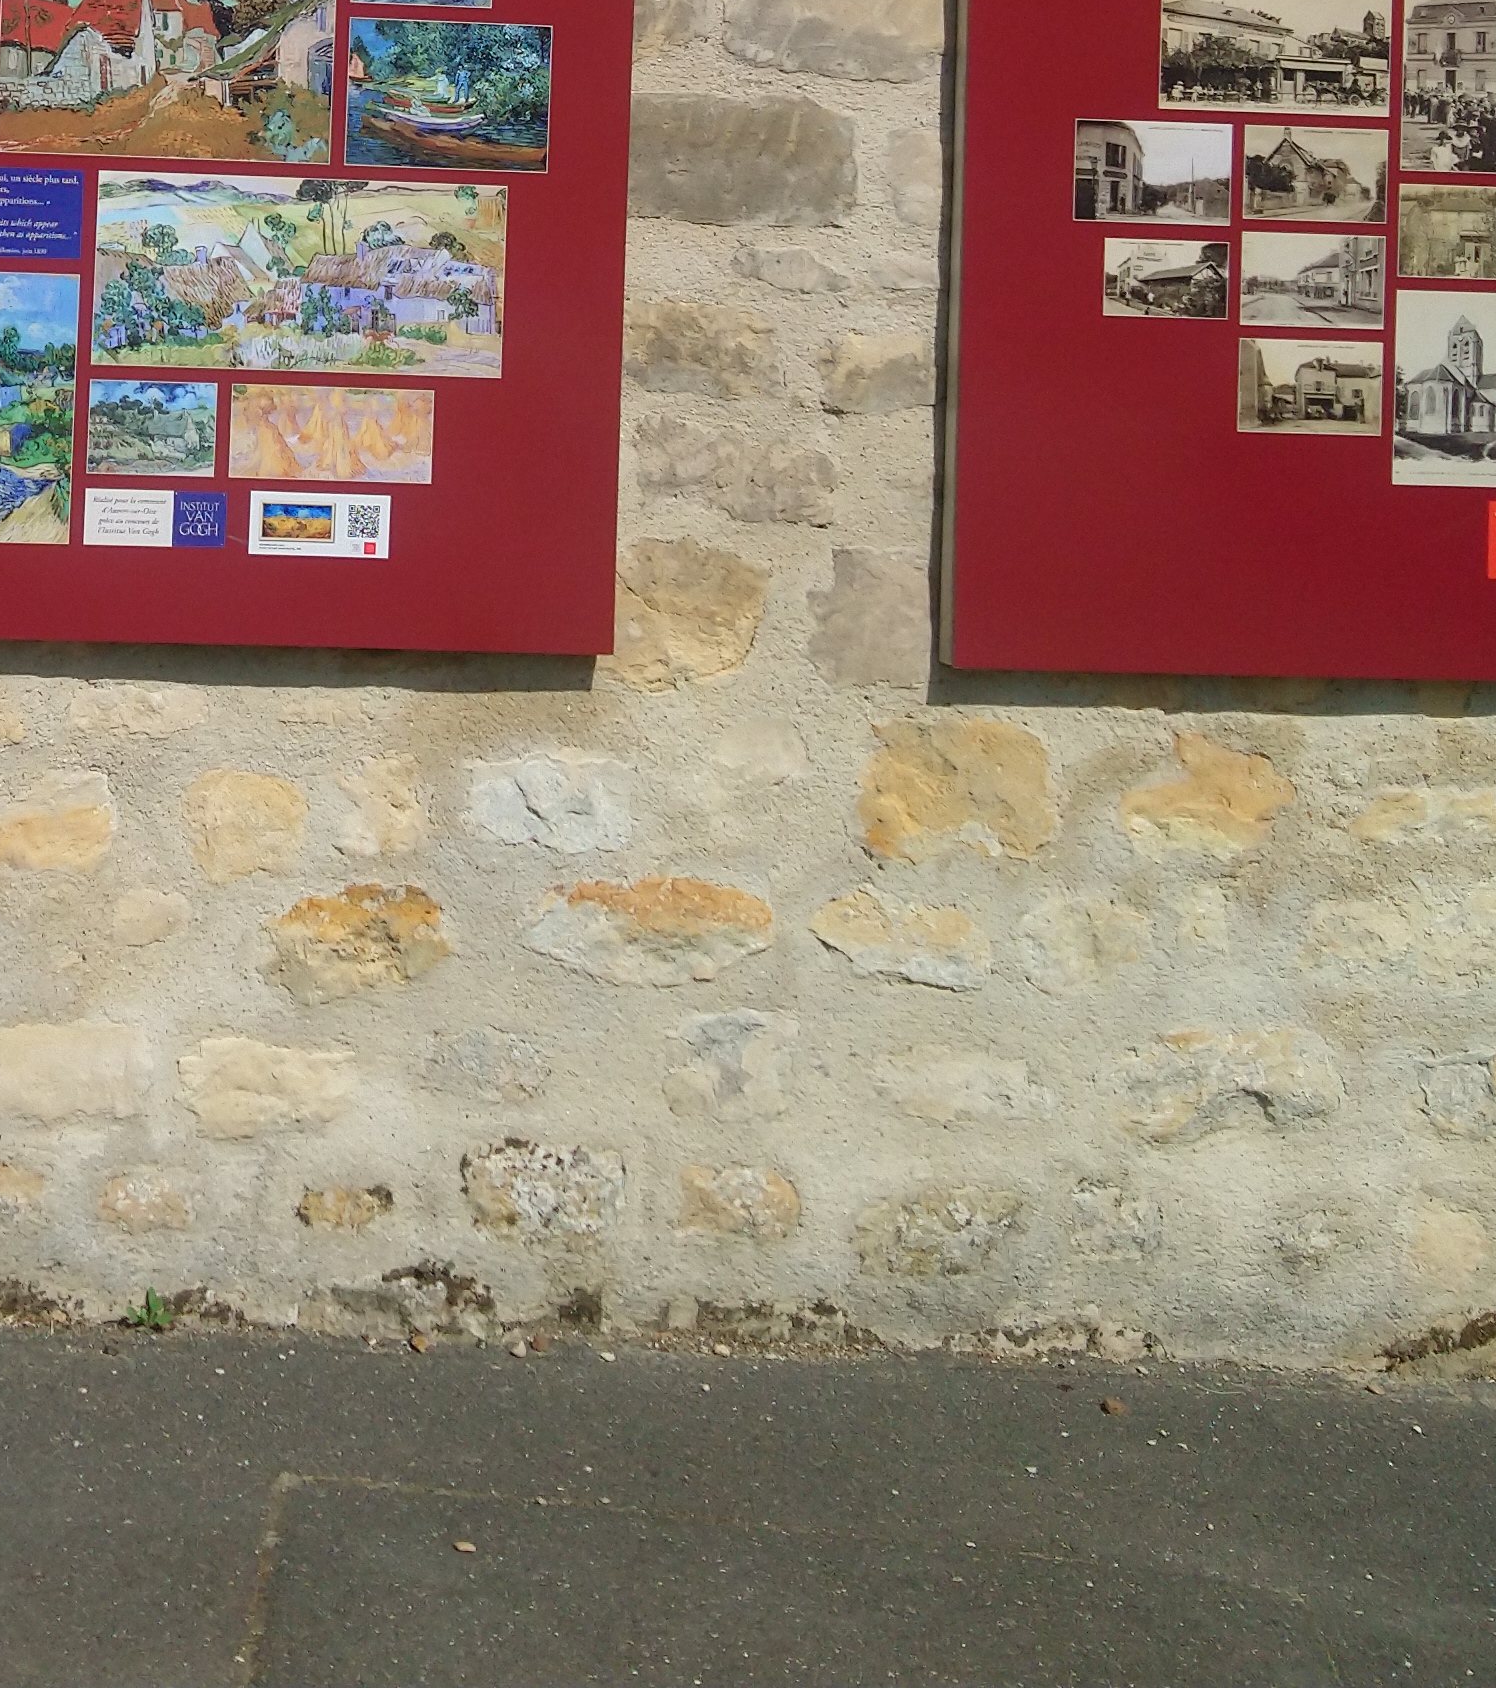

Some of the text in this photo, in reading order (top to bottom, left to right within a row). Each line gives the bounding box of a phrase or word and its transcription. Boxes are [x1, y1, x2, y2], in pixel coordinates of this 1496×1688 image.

[180, 501, 220, 511] INSTITUT
[186, 511, 214, 522] VAN
[179, 522, 218, 536] GOGH
